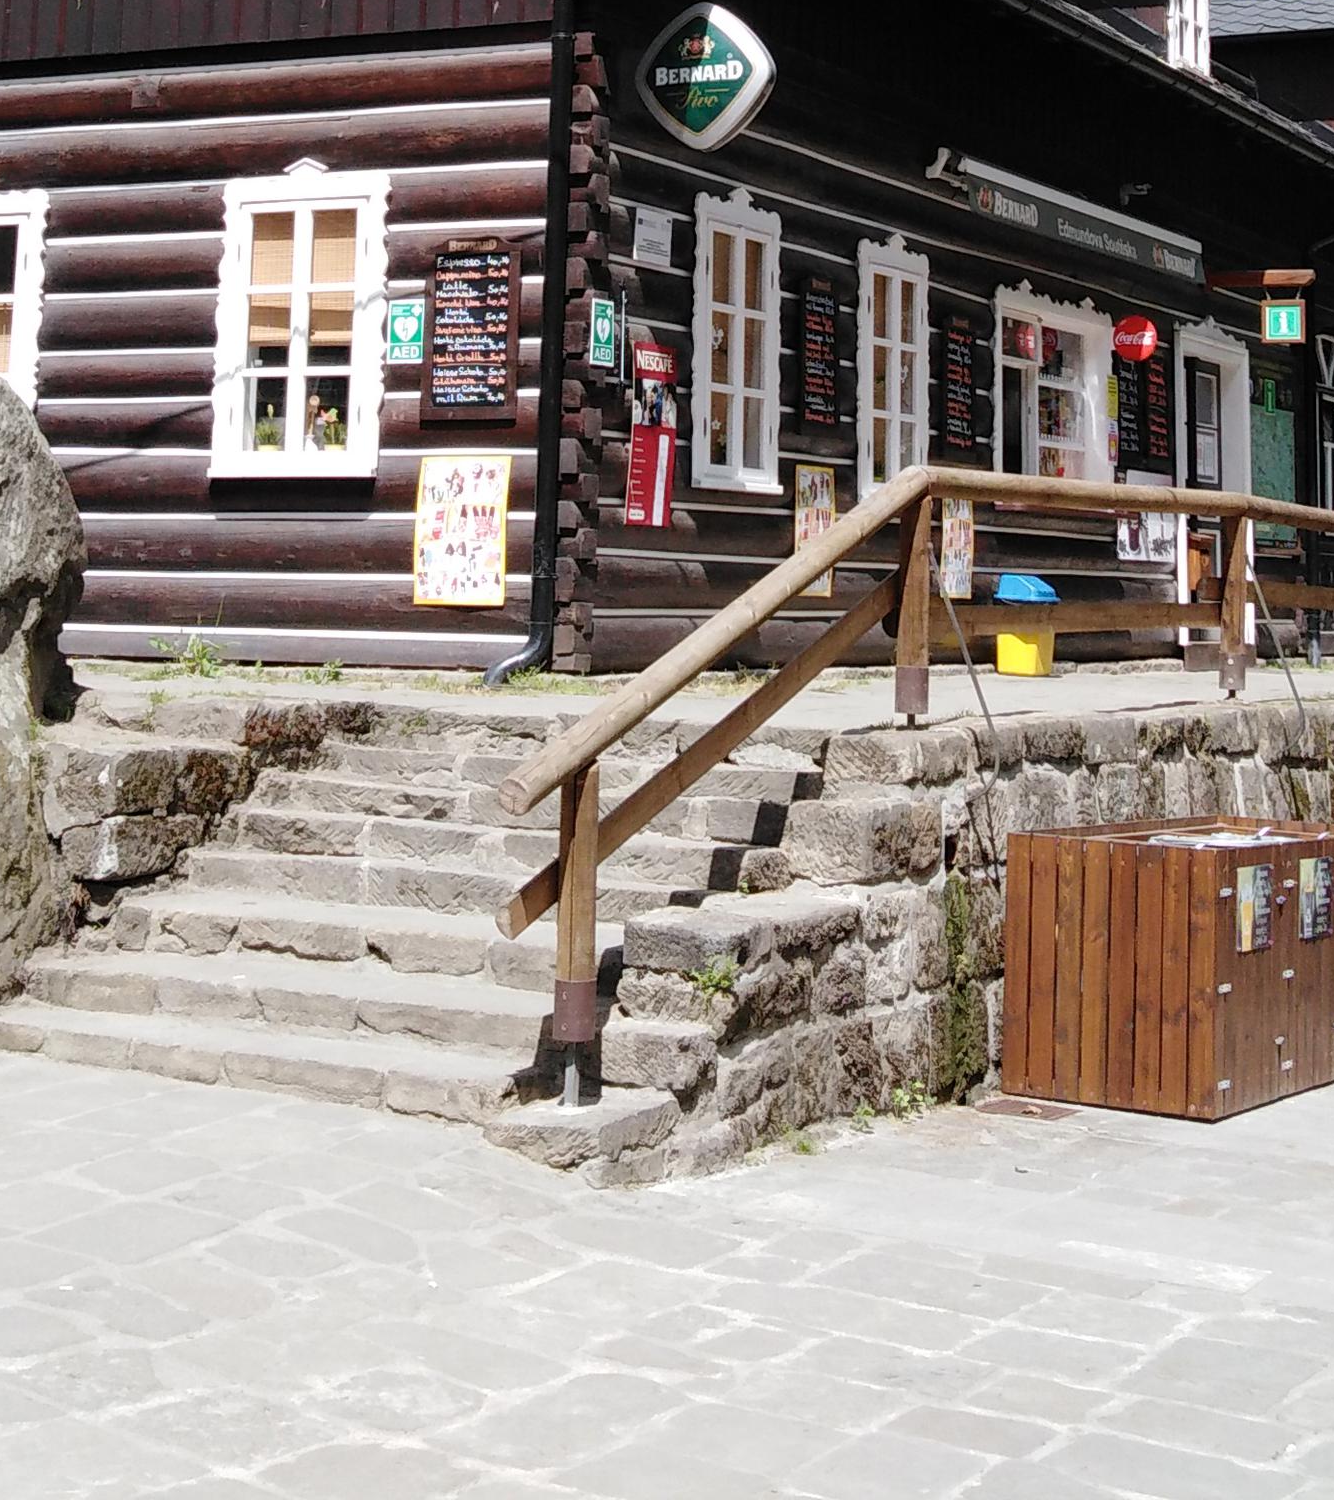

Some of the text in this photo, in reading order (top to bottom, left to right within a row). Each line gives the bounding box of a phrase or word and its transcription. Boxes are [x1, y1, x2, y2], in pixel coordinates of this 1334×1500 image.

[655, 60, 744, 86] BERNARD
[993, 190, 1039, 227] BERNARD
[1057, 218, 1104, 250] Edmundova
[392, 346, 420, 359] AED
[594, 347, 612, 360] AED
